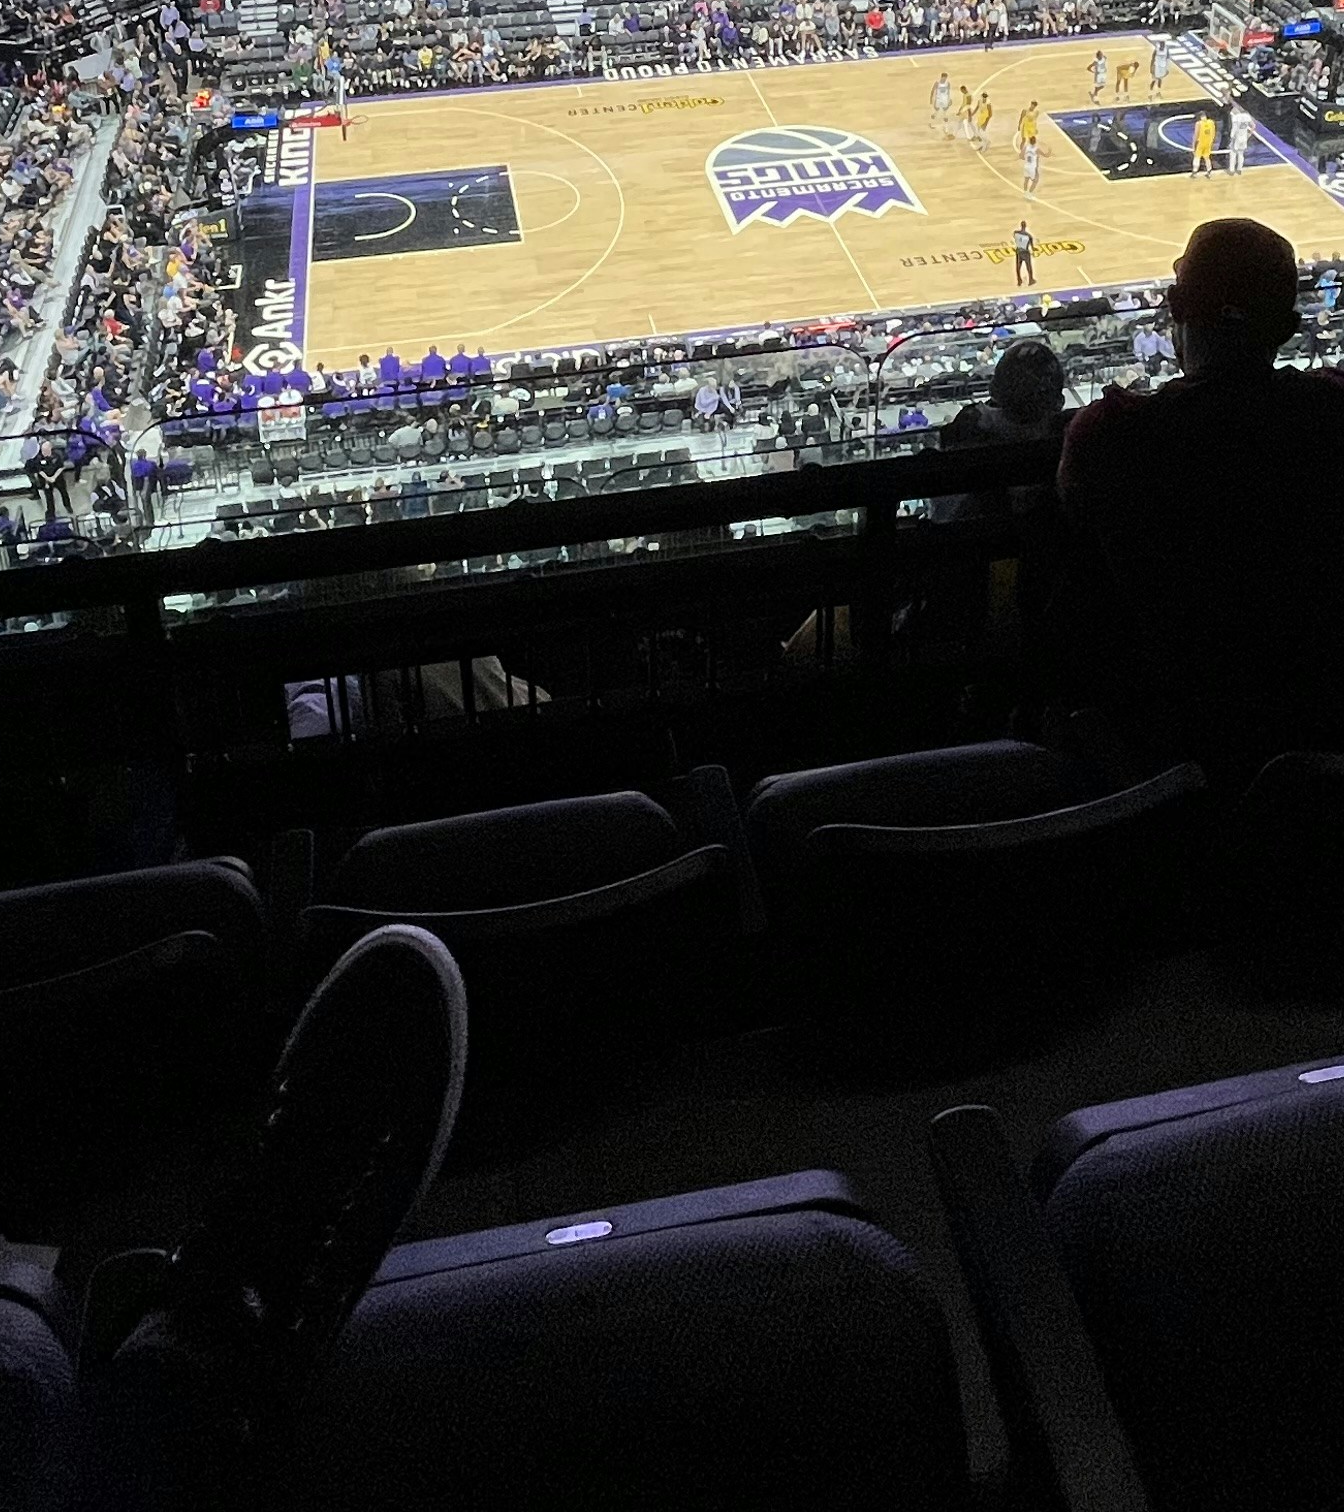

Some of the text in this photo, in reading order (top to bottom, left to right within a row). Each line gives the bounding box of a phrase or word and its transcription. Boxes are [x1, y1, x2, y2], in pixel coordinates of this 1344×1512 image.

[603, 45, 880, 82] SACRAMENTO PROUD
[566, 102, 638, 118] CENTER
[711, 154, 893, 188] KINGS
[730, 175, 896, 202] SACRAMENTO
[900, 250, 984, 269] CENTER
[982, 240, 1087, 265] Goldn1
[251, 277, 297, 340] Ankr
